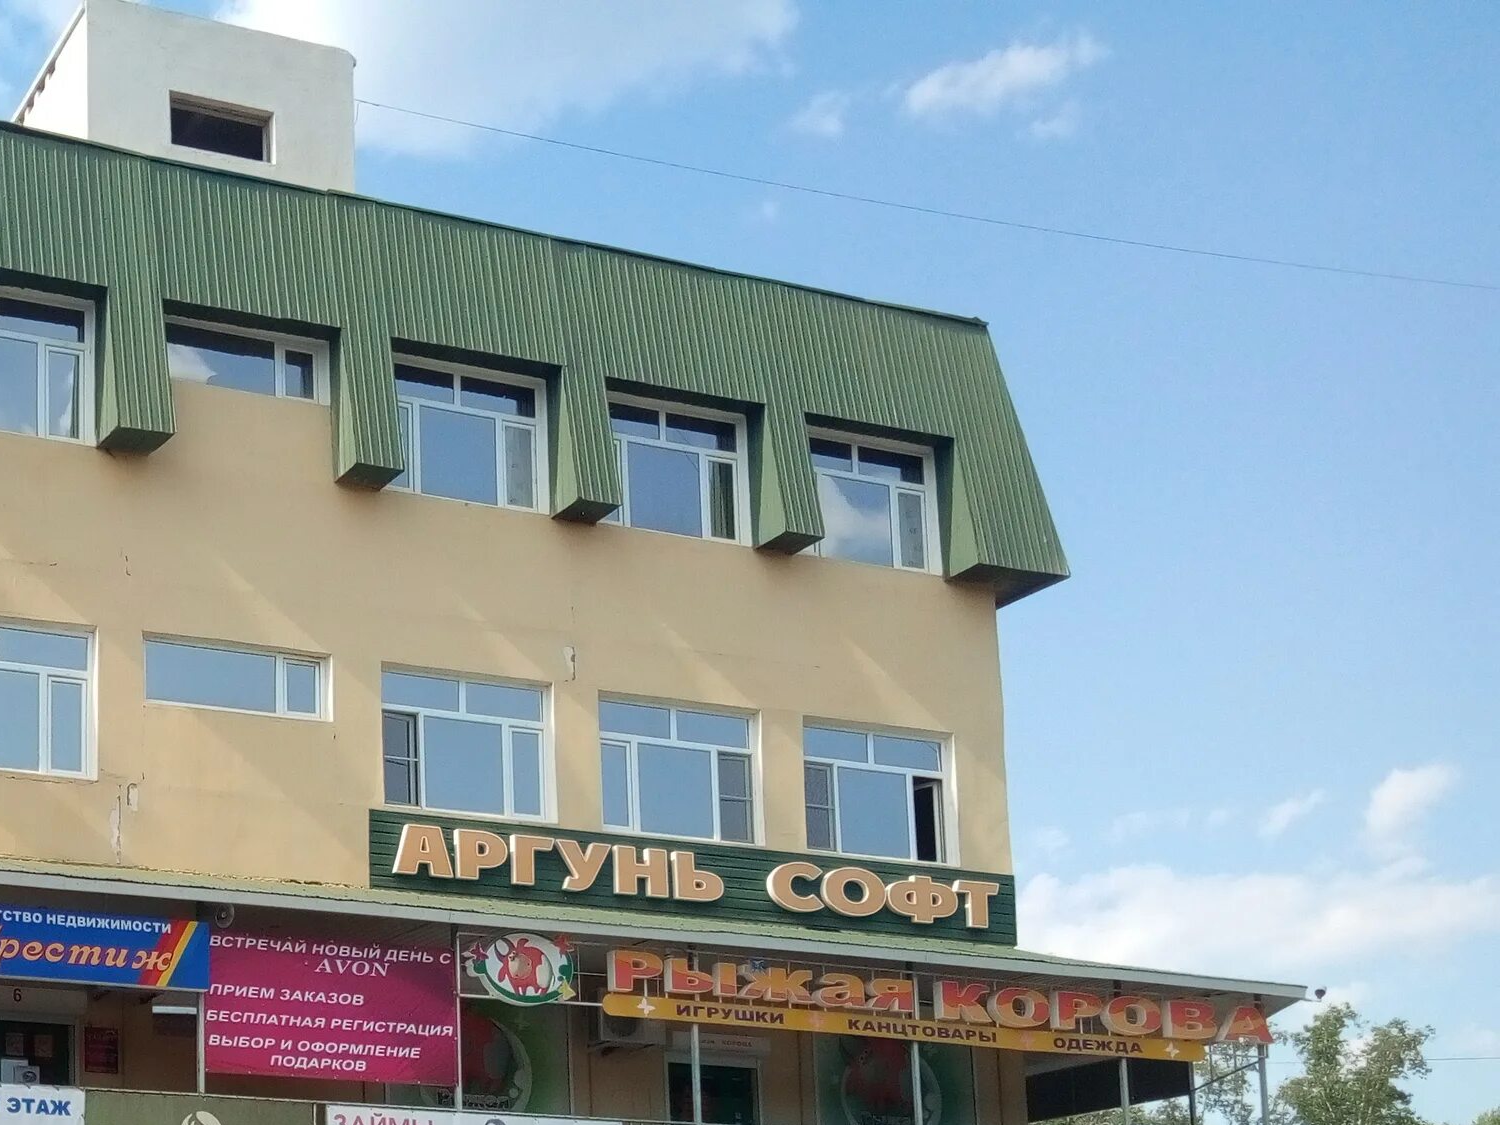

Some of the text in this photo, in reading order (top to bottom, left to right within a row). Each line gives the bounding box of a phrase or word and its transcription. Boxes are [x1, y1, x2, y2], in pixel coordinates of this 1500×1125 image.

[391, 822, 1000, 930] АРГУНЬ СОФТ
[46, 914, 172, 935] НЕДВИЖИМОСТИ
[209, 935, 451, 965] ВСТРЕЧАЙ НОВЫЙ ДЕНЬ С
[314, 958, 390, 977] AVON
[13, 988, 22, 1002] 6
[209, 984, 365, 1006] ПРИЕМ ЗАКАЗОВ
[606, 949, 1275, 1044] Рыжая КОРОВА
[206, 1009, 453, 1037] БЕСПЛАТНАЯ РЕГИСТРАЦИЯ
[676, 1004, 1144, 1055] ИГРУШКИ КАНЦТОВАРЫ ОДЕЖДА
[208, 1035, 421, 1058] ВЫБОР И ОФОРМЛЕНИЕ
[270, 1055, 367, 1072] ПОДАРКОВ
[7, 1098, 72, 1116] ЭТАЖ
